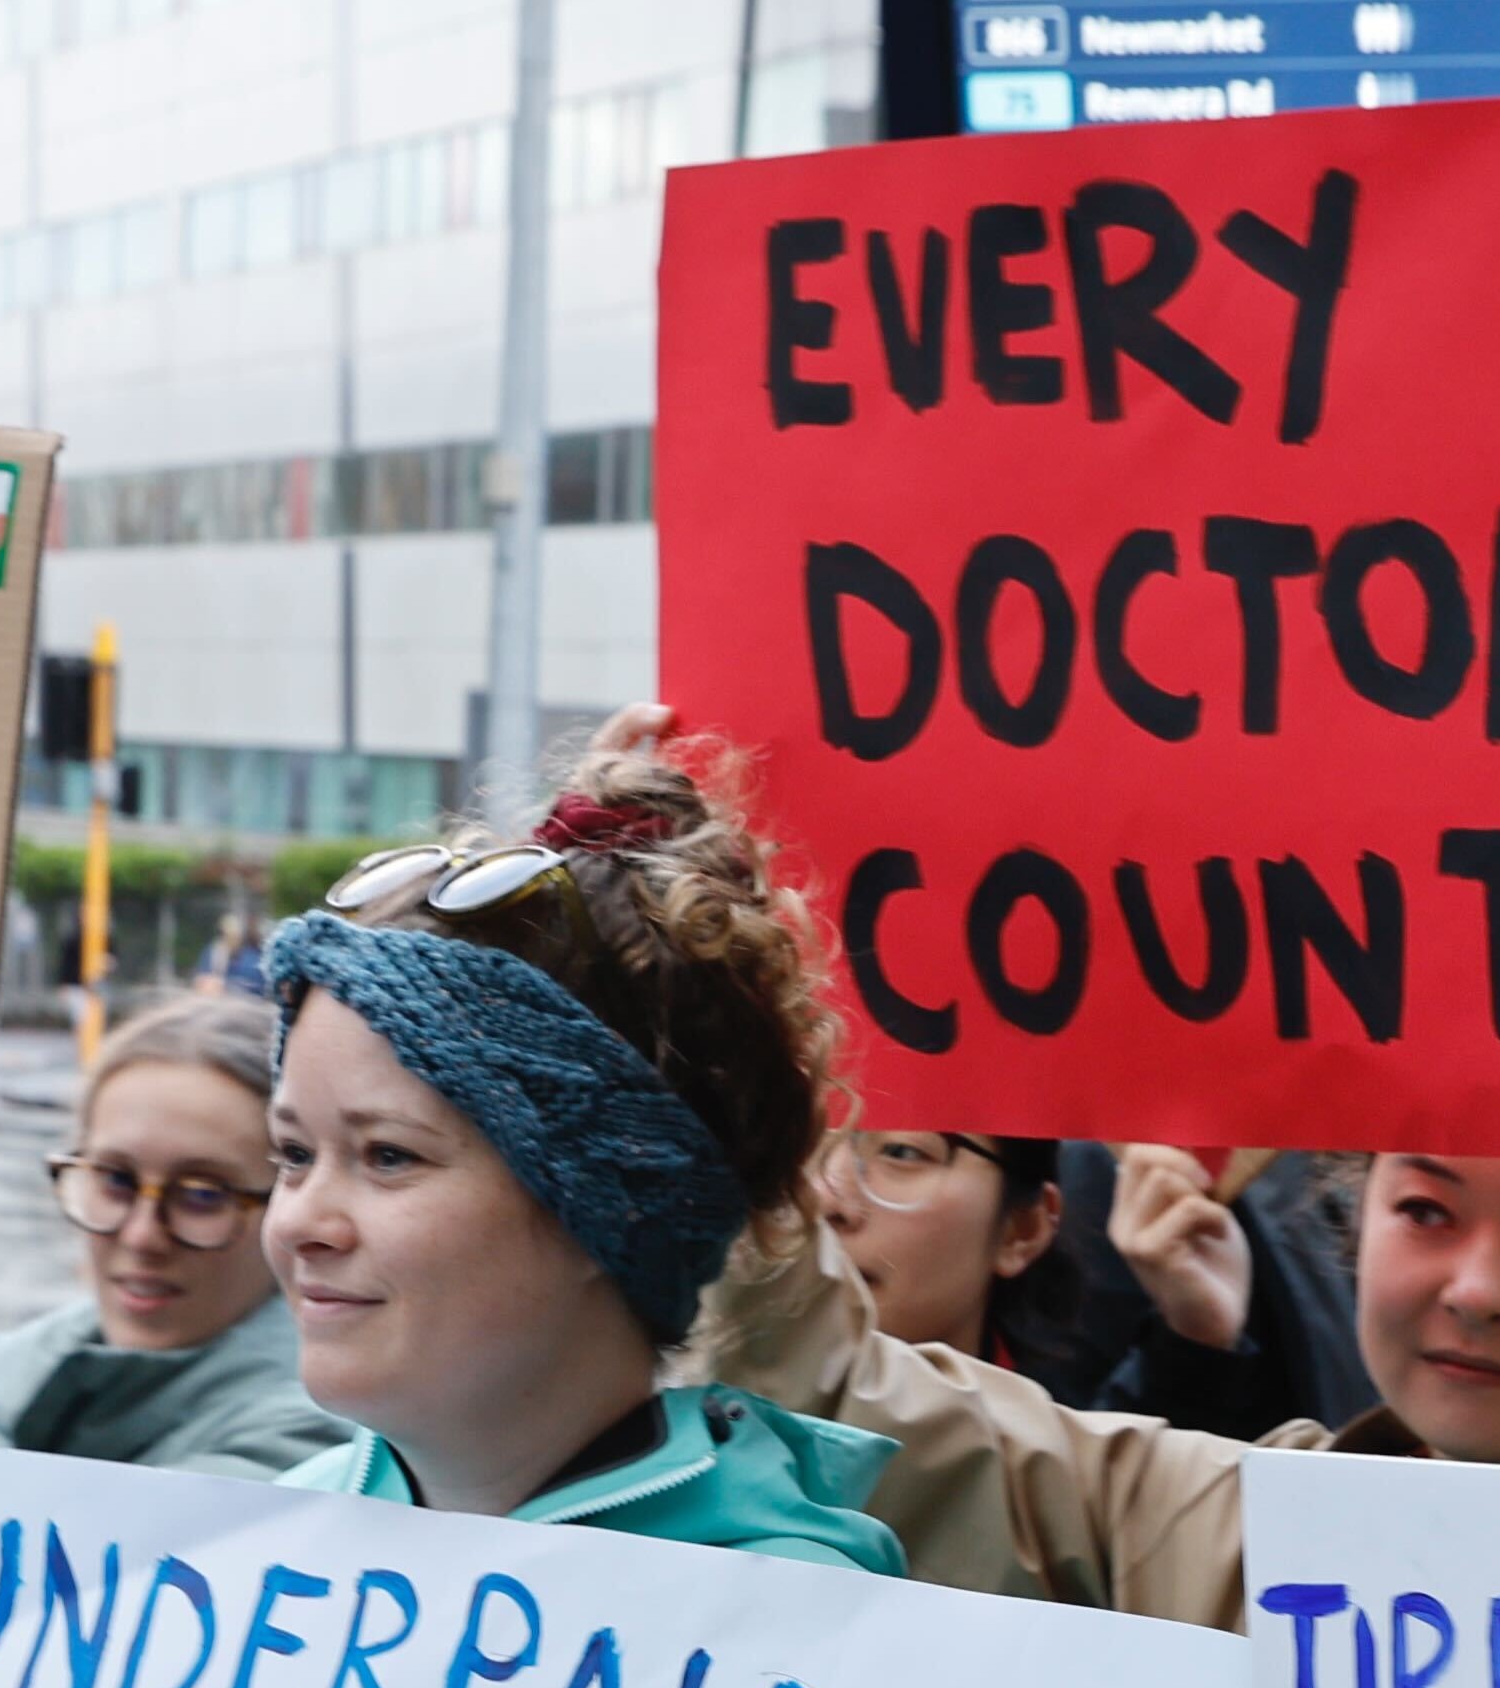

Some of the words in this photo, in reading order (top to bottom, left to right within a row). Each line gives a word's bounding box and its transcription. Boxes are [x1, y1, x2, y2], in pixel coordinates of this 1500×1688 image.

[1080, 11, 1267, 55] Newmarket
[1083, 81, 1226, 121] Remuera
[762, 165, 1366, 447] EVERY
